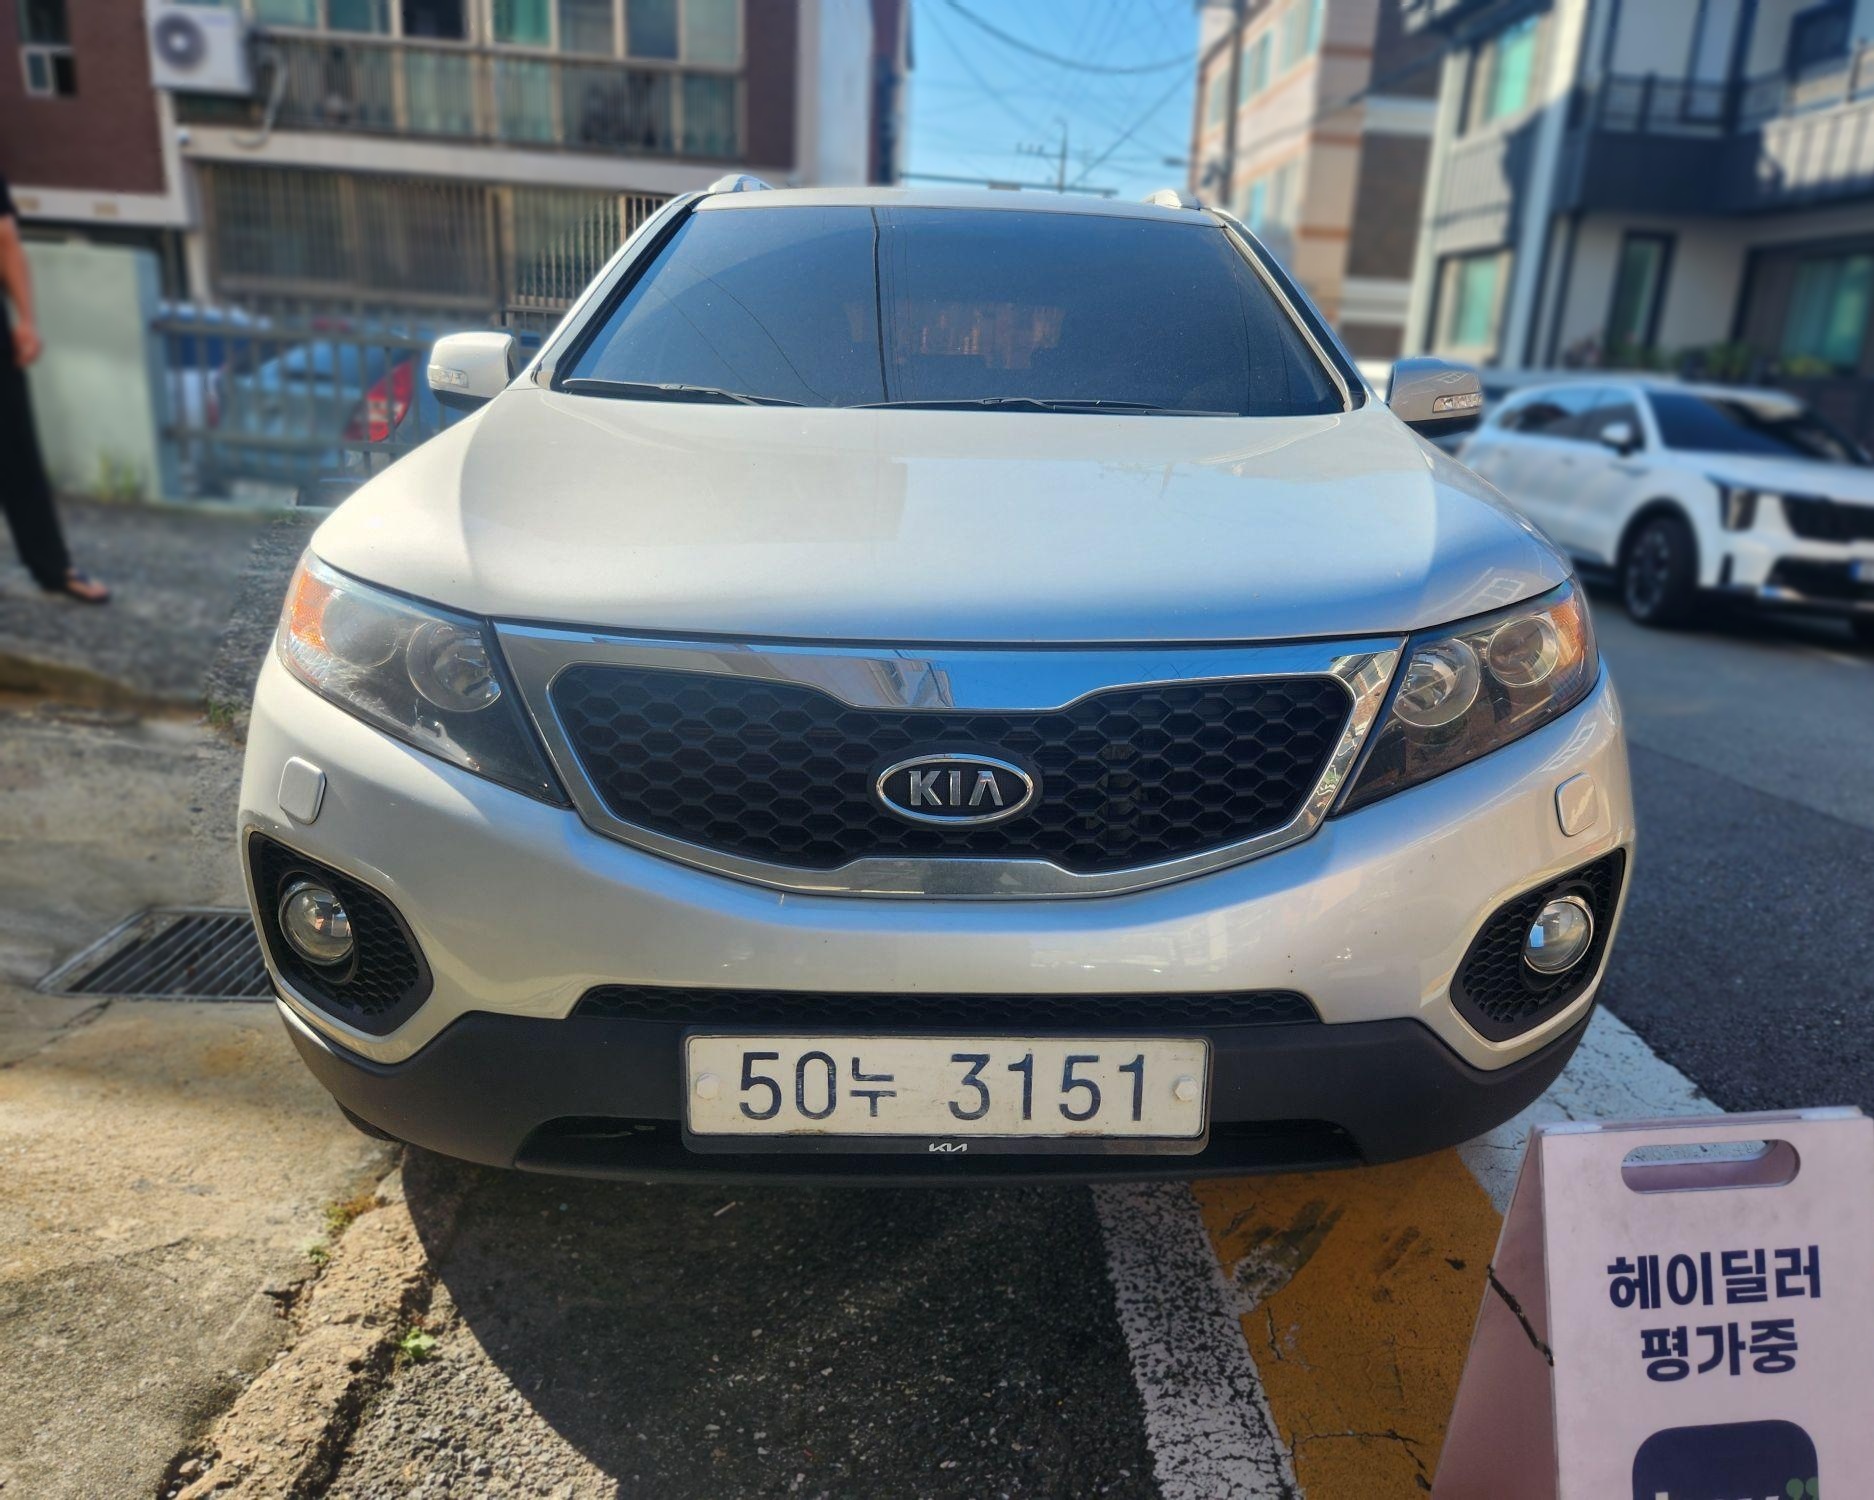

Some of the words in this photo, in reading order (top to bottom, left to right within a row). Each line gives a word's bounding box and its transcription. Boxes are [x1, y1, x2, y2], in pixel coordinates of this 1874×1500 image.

[908, 770, 1004, 806] KIA
[739, 1051, 897, 1121] 50누
[949, 1054, 1144, 1121] 3151
[1607, 1245, 1821, 1309] 헤이딜러
[1641, 1319, 1798, 1382] 평가중
